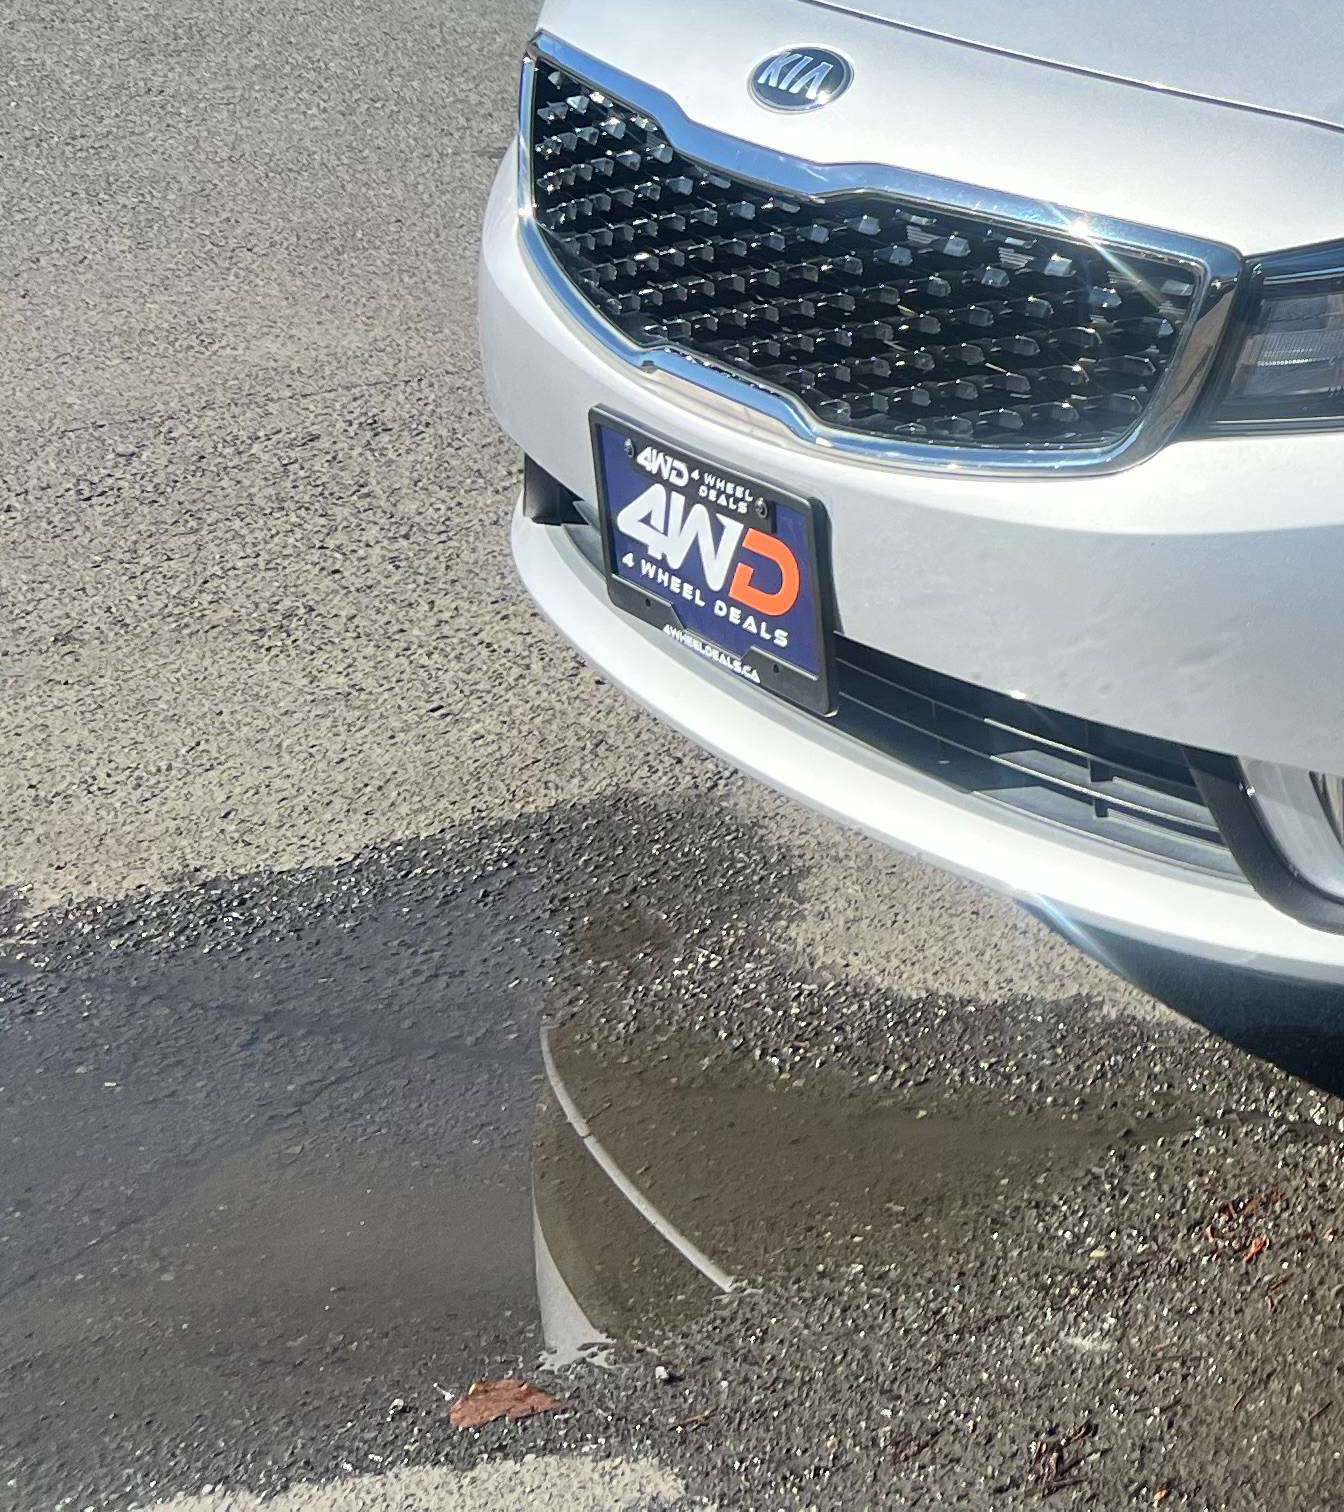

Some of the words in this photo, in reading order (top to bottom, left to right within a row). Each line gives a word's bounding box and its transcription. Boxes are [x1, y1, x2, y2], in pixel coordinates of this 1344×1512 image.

[757, 51, 834, 100] KIA
[636, 446, 689, 487] 4WD
[690, 469, 700, 481] 4
[703, 472, 754, 502] WHEEL
[698, 485, 748, 515] DEALS
[616, 483, 799, 616] 4WD
[621, 552, 635, 568] 4
[640, 559, 706, 608] WHEEL
[713, 599, 789, 648] DEALS
